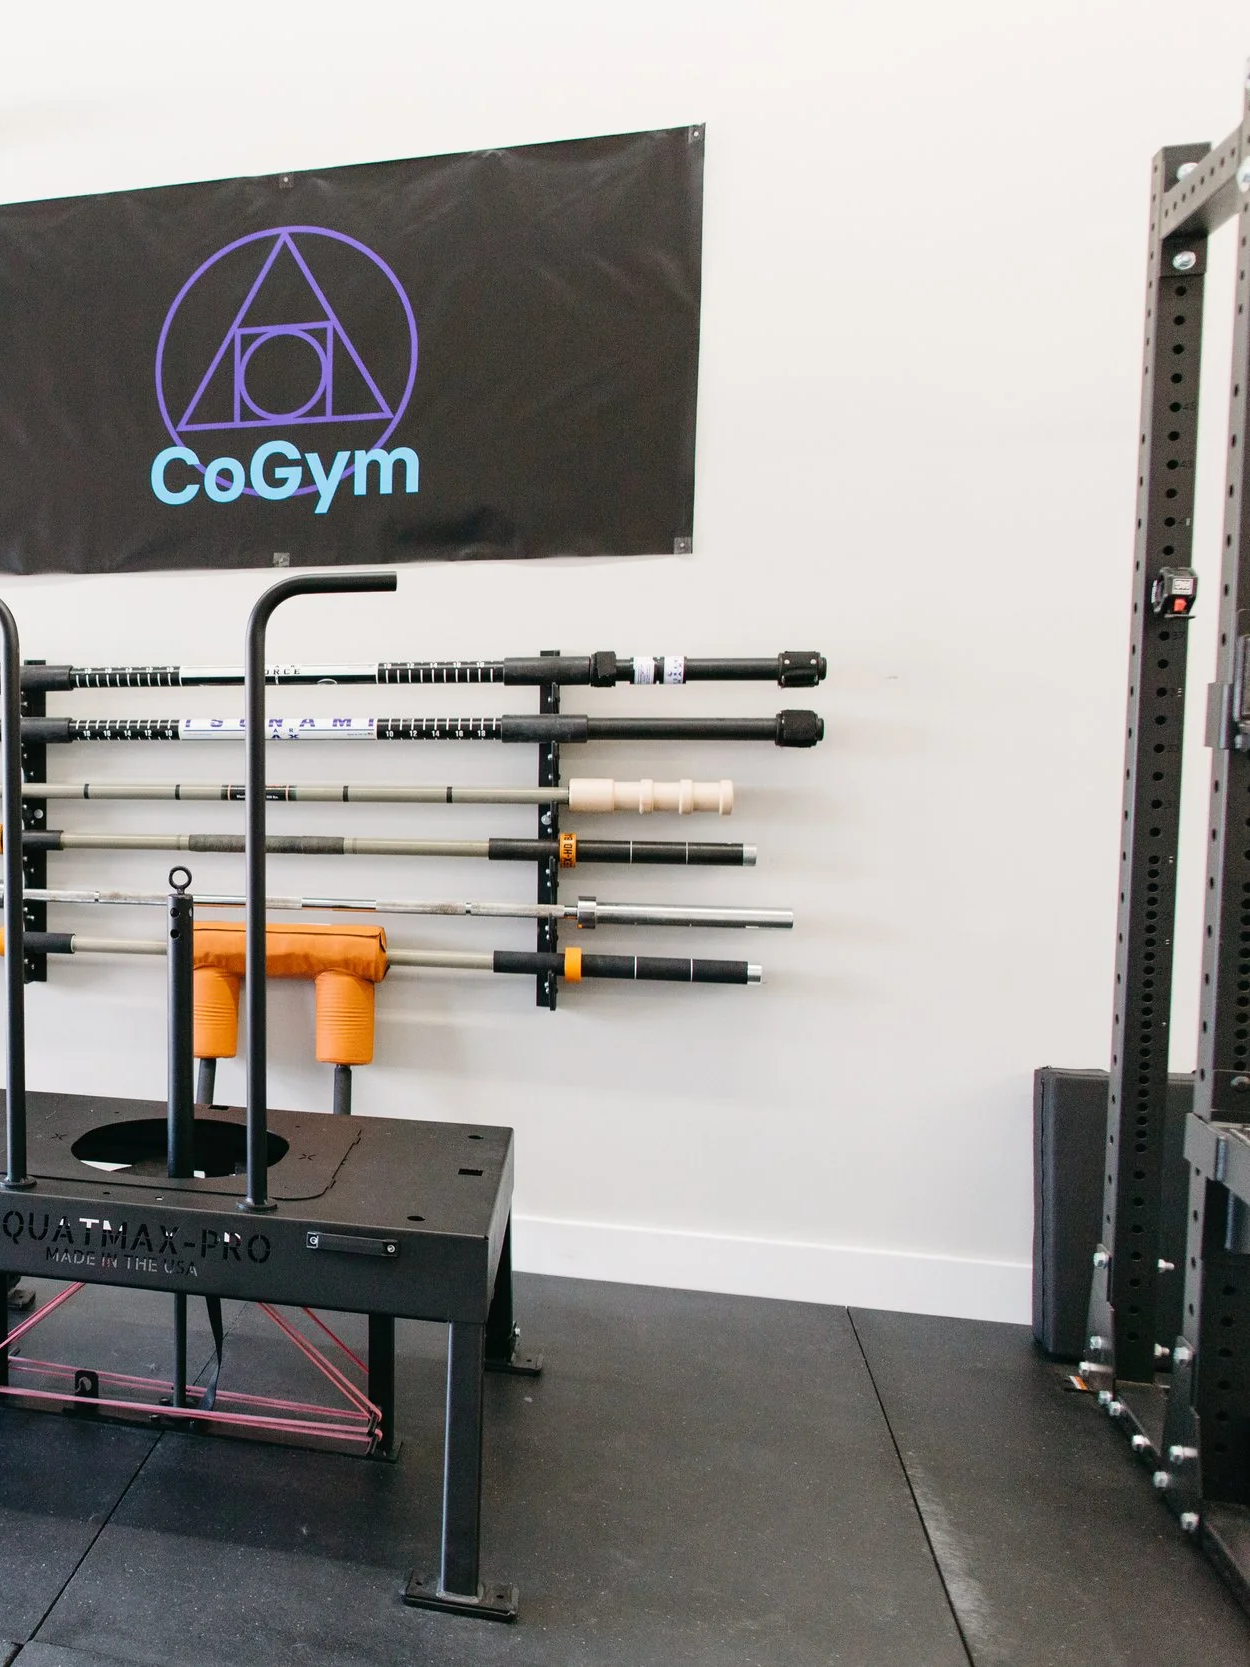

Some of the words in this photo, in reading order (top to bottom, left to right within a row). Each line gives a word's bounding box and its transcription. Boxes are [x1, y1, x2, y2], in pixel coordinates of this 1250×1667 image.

[150, 440, 420, 514] CoGym
[46, 1246, 96, 1266] MADE
[102, 1252, 118, 1269] IN
[123, 1254, 158, 1273] THE
[164, 1258, 198, 1277] USA
